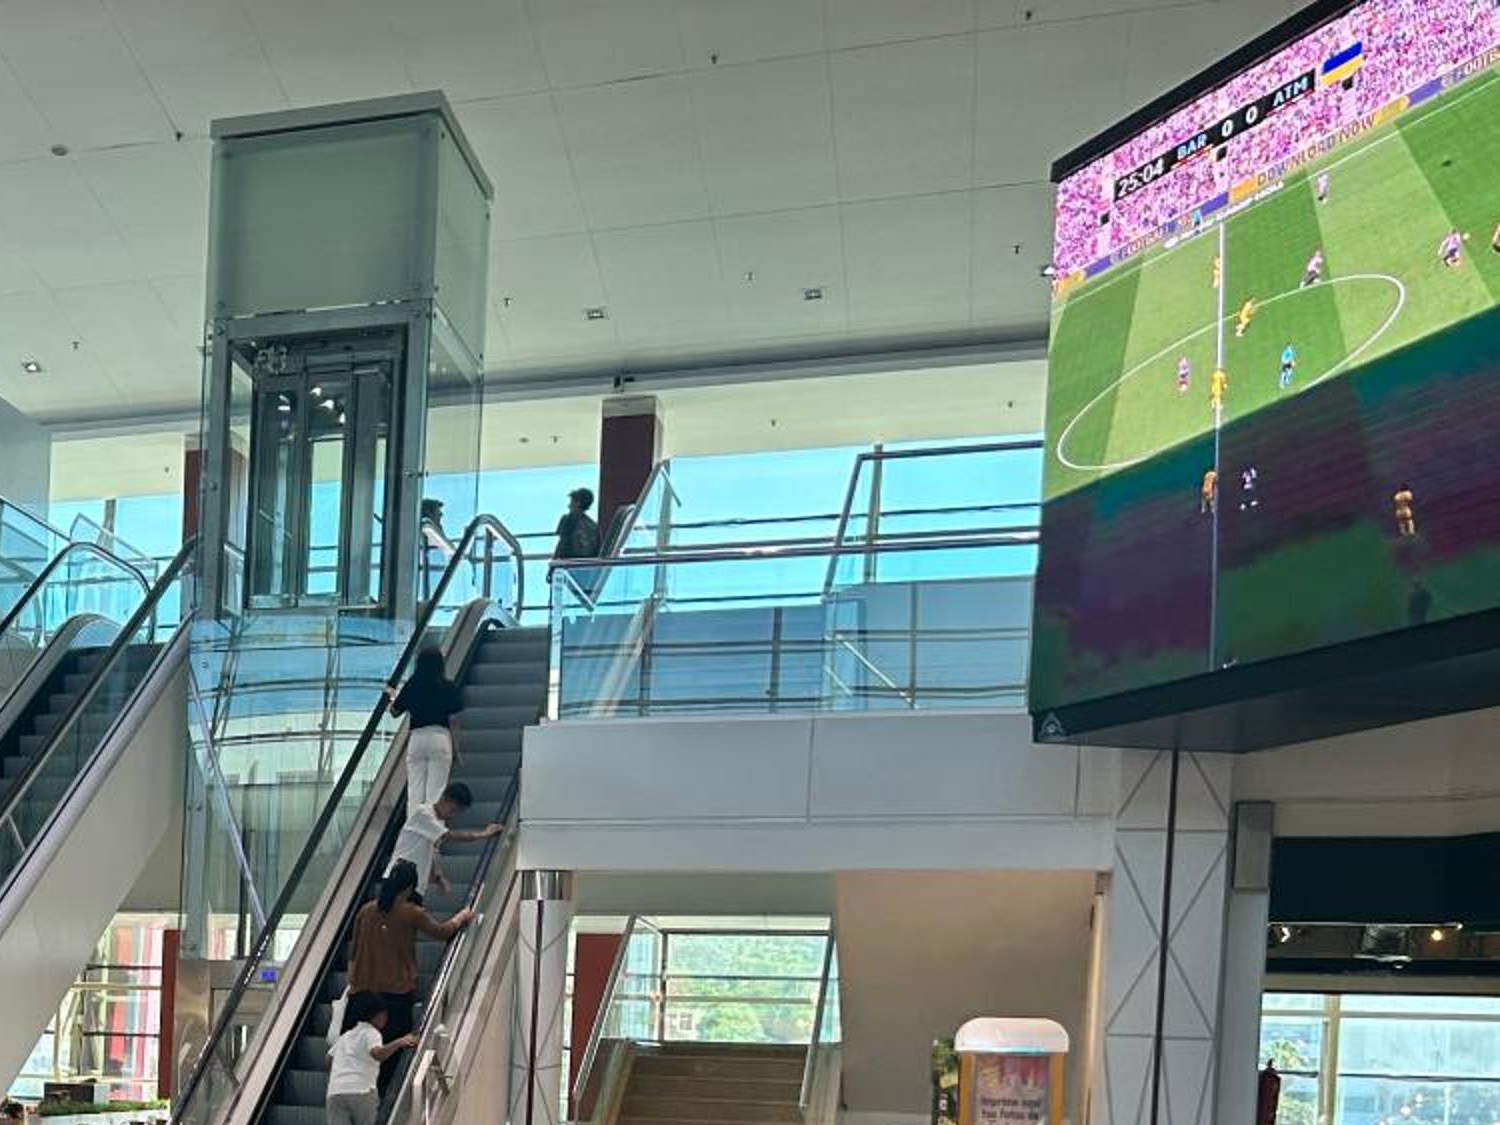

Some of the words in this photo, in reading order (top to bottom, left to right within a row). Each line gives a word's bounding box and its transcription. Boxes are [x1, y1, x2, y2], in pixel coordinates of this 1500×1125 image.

[1117, 160, 1165, 198] 25:04
[1176, 134, 1208, 160] BAR
[1221, 119, 1234, 138] 0
[1245, 106, 1258, 124] 0
[1273, 76, 1309, 107] ATM
